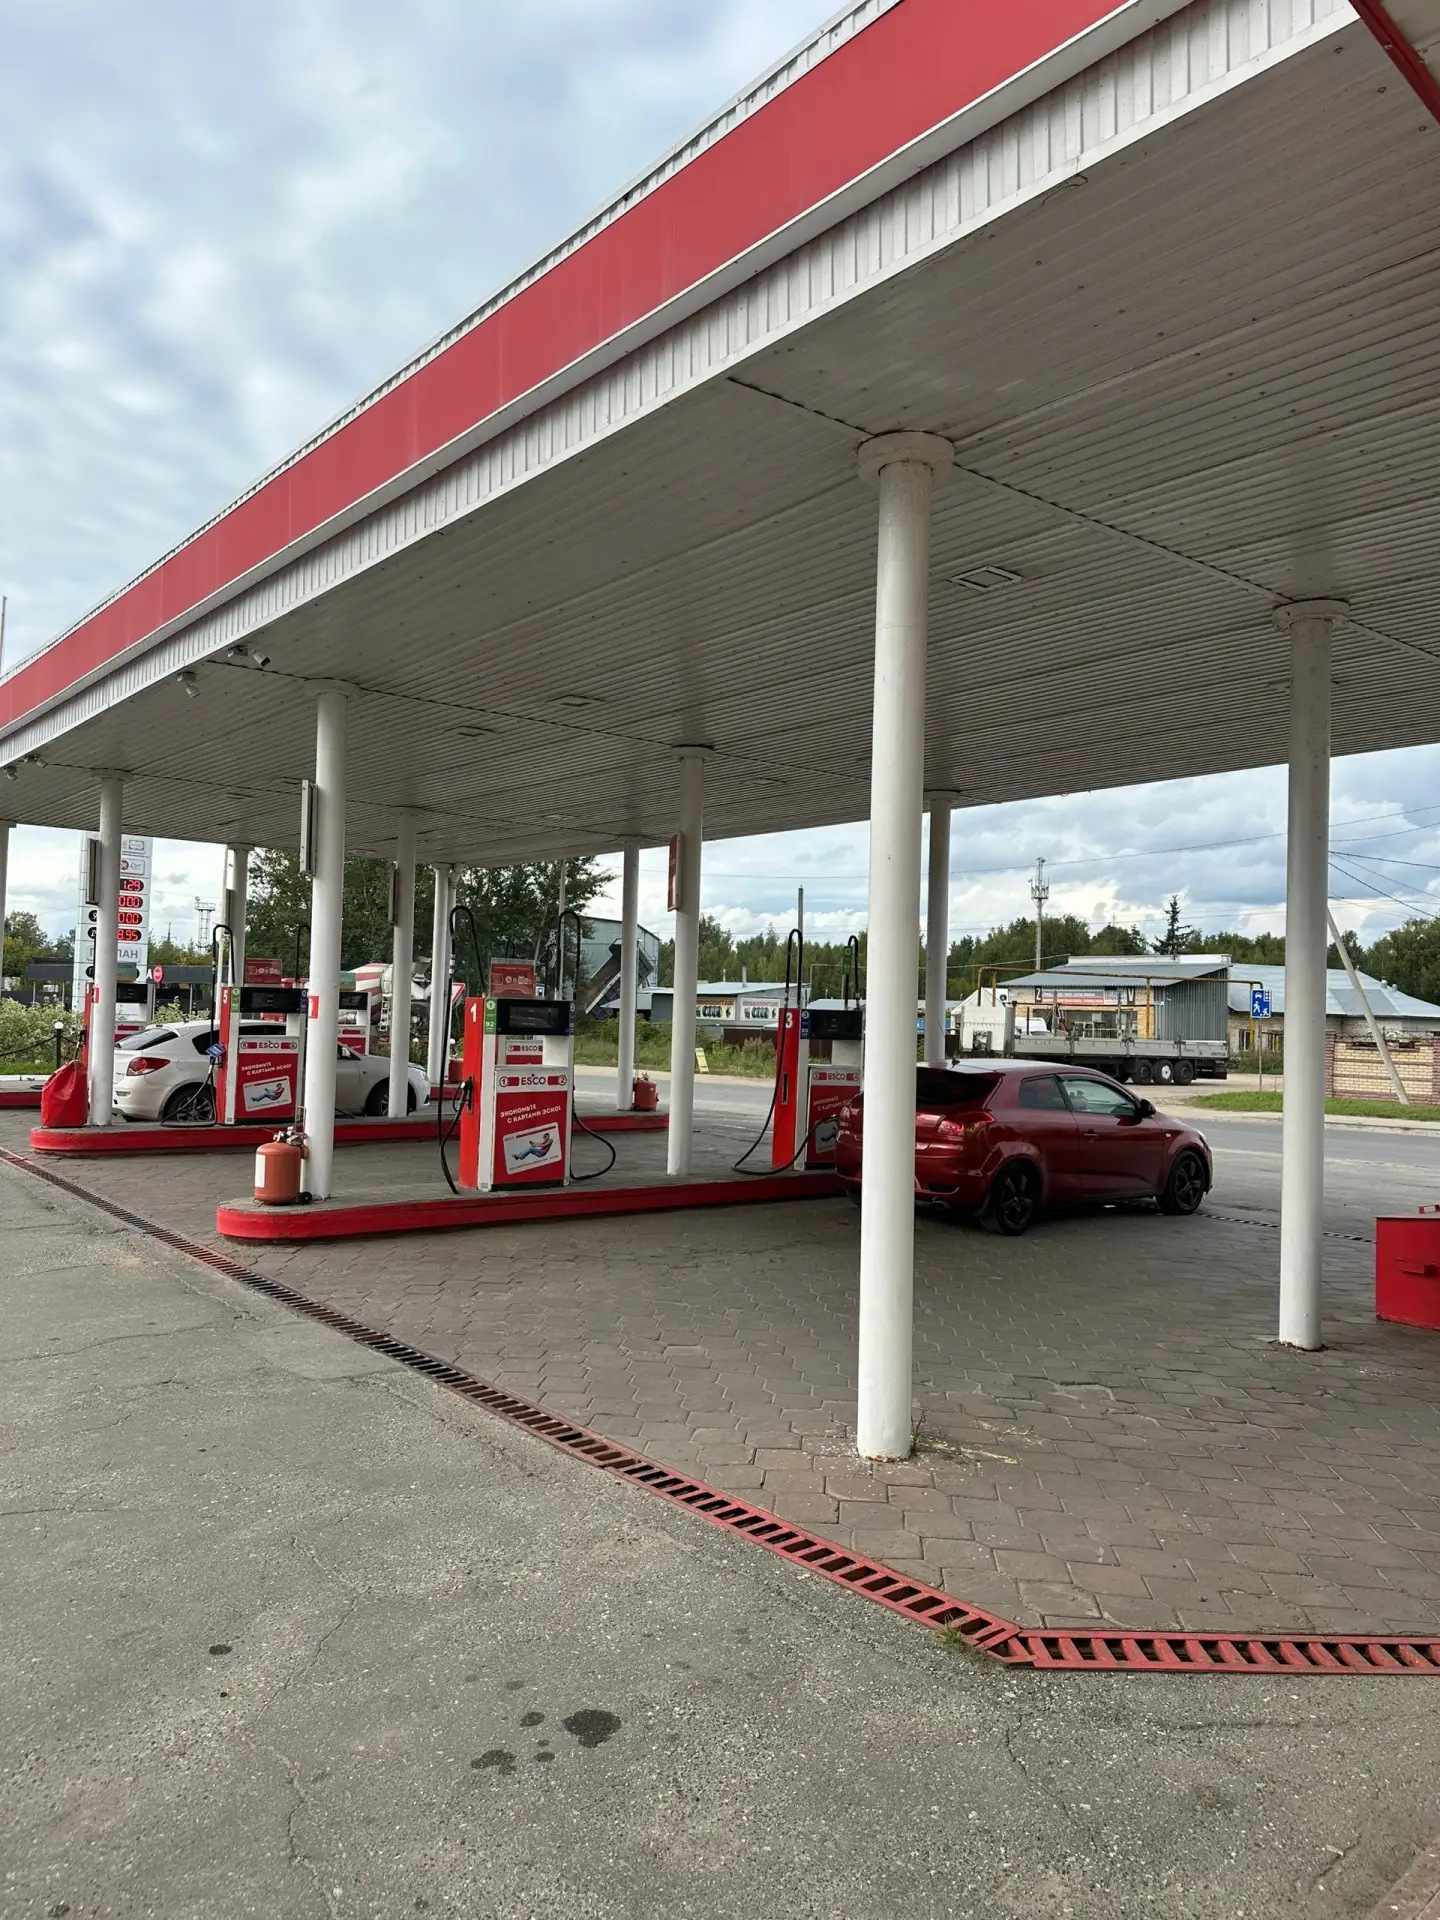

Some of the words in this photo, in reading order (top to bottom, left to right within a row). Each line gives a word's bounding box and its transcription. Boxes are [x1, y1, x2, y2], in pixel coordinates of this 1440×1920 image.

[122, 880, 141, 891] 1.29
[116, 929, 139, 941] 8.95
[222, 989, 228, 1004] 5
[1127, 988, 1134, 1002] V
[470, 1002, 477, 1023] 1
[785, 1012, 793, 1029] 3
[258, 1041, 280, 1049] ESCO
[520, 1075, 547, 1086] ESCO
[827, 1072, 846, 1080] ESCO
[513, 1110, 542, 1122] КАРТАМИ
